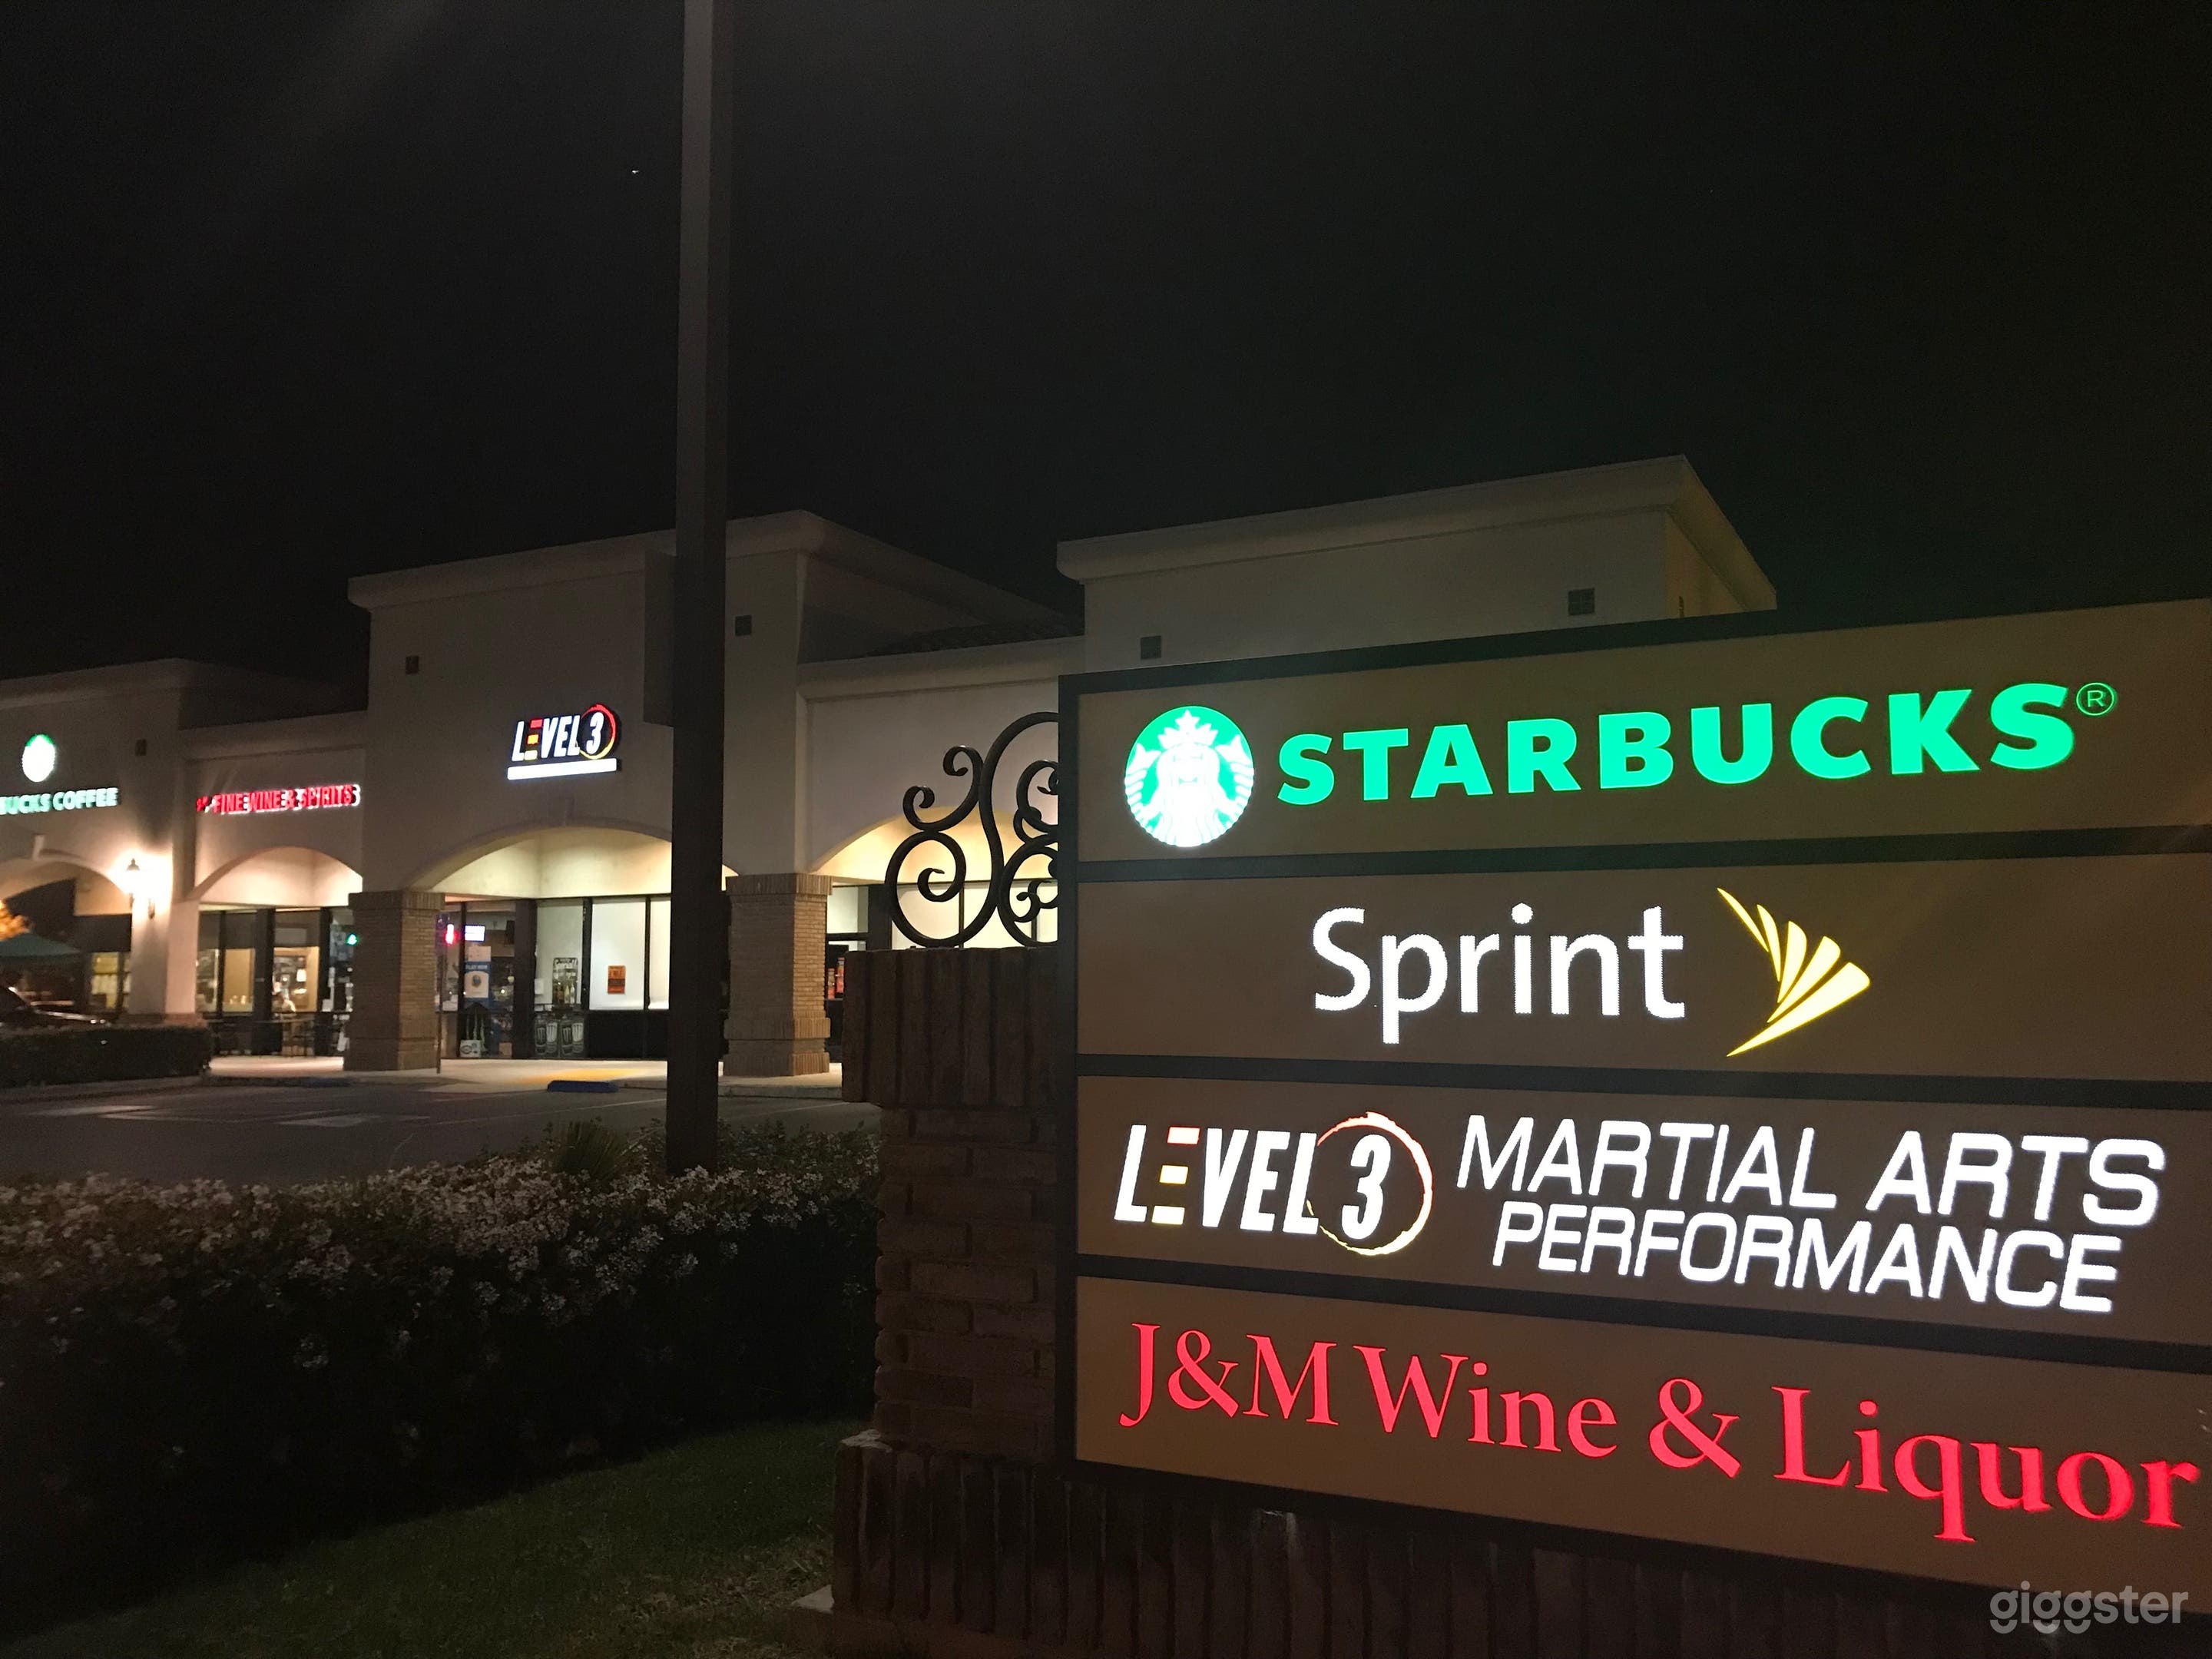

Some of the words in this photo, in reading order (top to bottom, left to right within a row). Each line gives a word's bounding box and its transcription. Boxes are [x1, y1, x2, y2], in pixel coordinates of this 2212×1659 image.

[512, 714, 581, 761] LEVEL
[586, 711, 604, 754] 3
[53, 787, 118, 811] COFFEE
[213, 793, 247, 814] FINE
[250, 790, 283, 812] WINE
[301, 784, 357, 808] SPIRITS
[1313, 903, 1684, 1044] Sprint
[1114, 1124, 1319, 1235] LEVEL
[1342, 1134, 1391, 1240] 3
[1457, 1115, 1836, 1208] MARTIAL
[1866, 1131, 2164, 1226] ARTS
[1493, 1201, 2121, 1312] PERFORMANCE
[1119, 1323, 1339, 1427] J&M
[1353, 1345, 1617, 1458] Wine
[1649, 1378, 1741, 1478] &
[1772, 1386, 2199, 1542] Liquor
